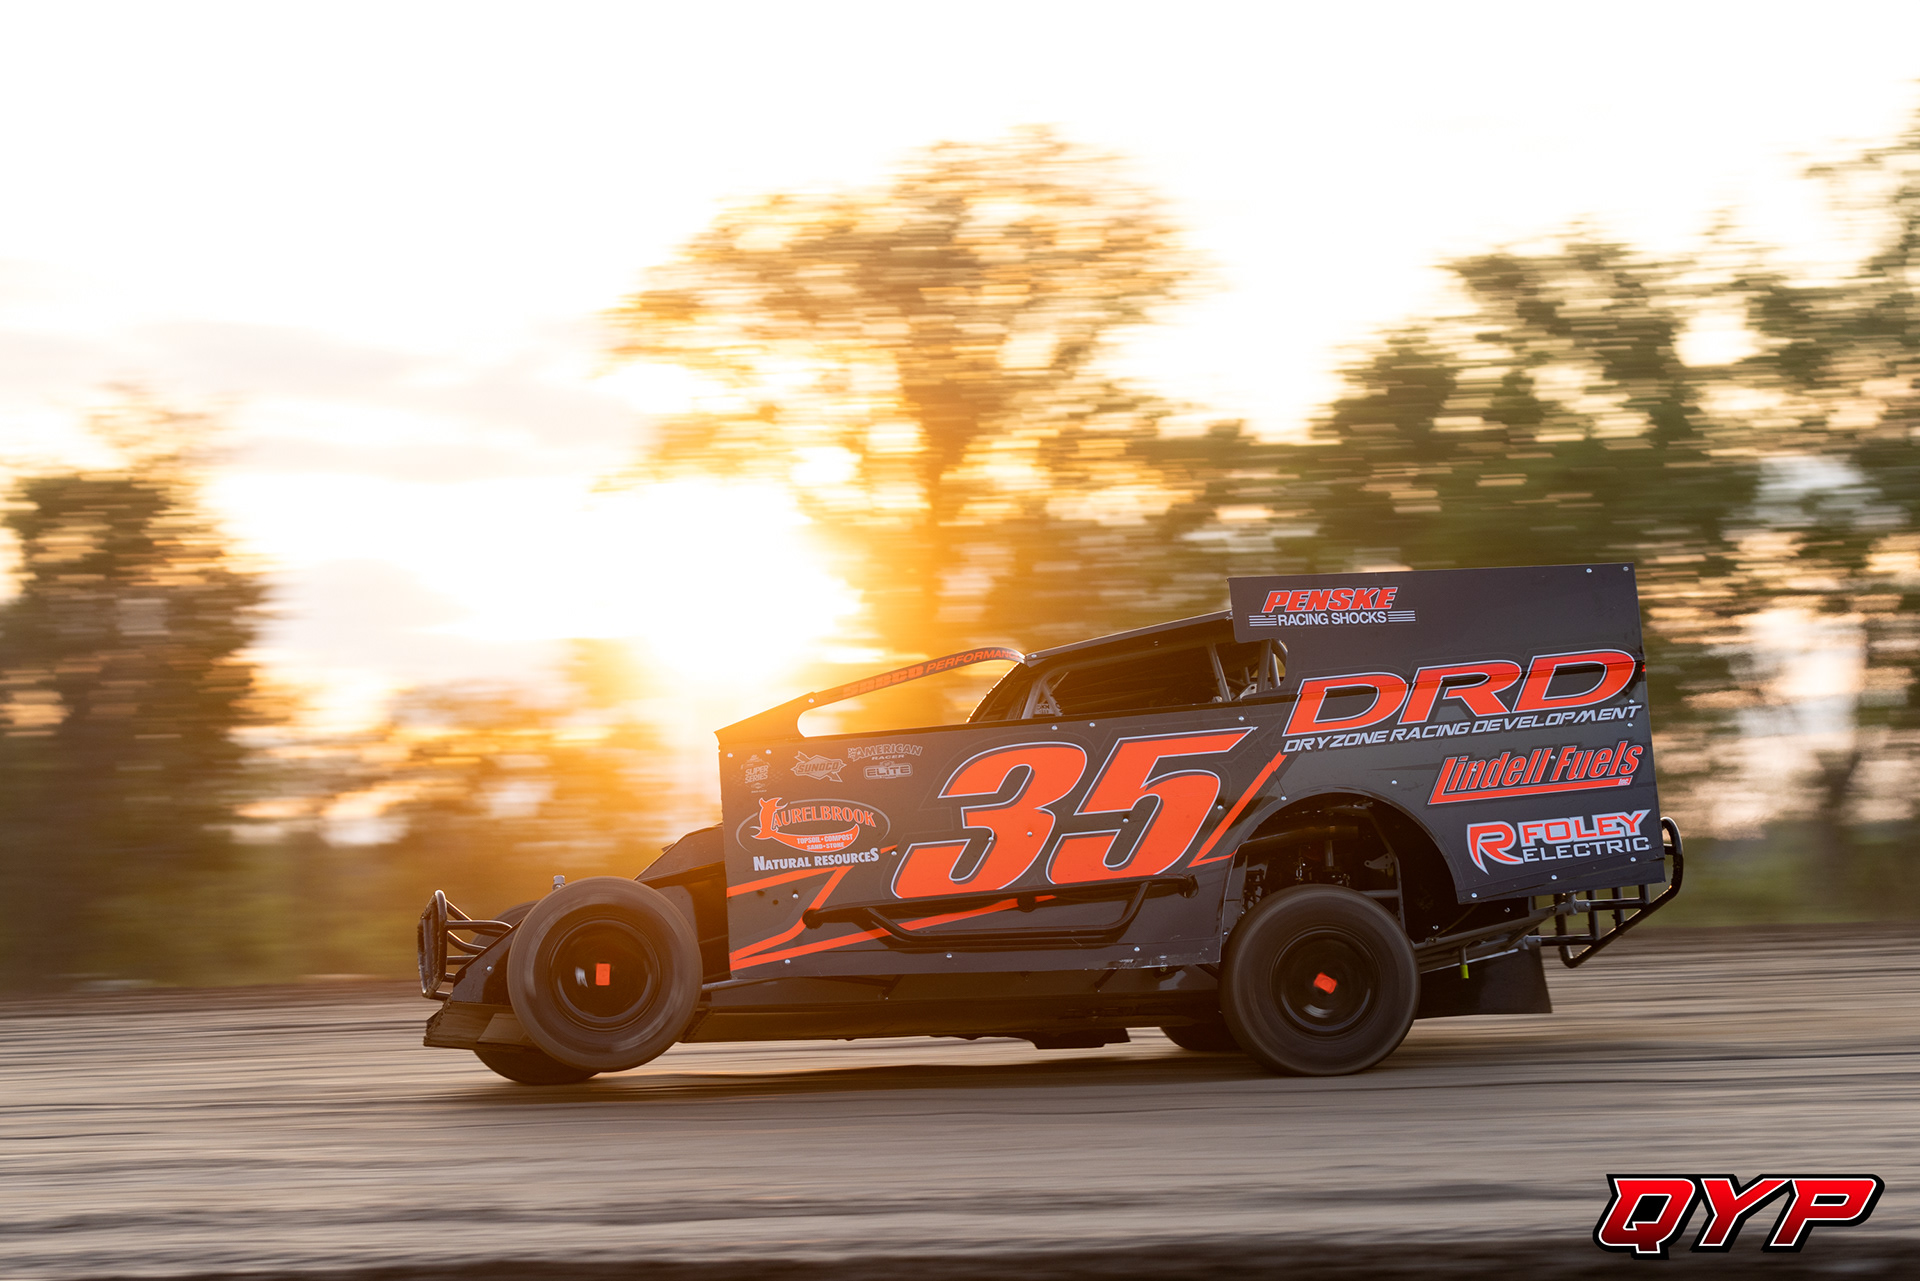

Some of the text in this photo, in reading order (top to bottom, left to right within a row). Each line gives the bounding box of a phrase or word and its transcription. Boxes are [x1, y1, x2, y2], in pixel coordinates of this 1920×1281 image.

[1261, 586, 1398, 613] PENSKE
[1277, 611, 1387, 626] RACING SHOCKS
[926, 650, 1020, 673] PERFORMANC
[1282, 649, 1637, 737] DRD
[1283, 705, 1642, 753] DRYZONE RACING DEVELOPMENT
[852, 743, 923, 762] AMERICAN
[744, 773, 769, 784] SERIES
[745, 765, 769, 776] SUPER
[797, 760, 840, 774] SUNOCO
[1428, 741, 1644, 805] Lindell Fuels
[891, 726, 1258, 899] 35
[1517, 809, 1651, 847] FOLEY
[753, 847, 879, 871] NATURAL RESOURCES
[1522, 836, 1650, 862] ELECTRIC
